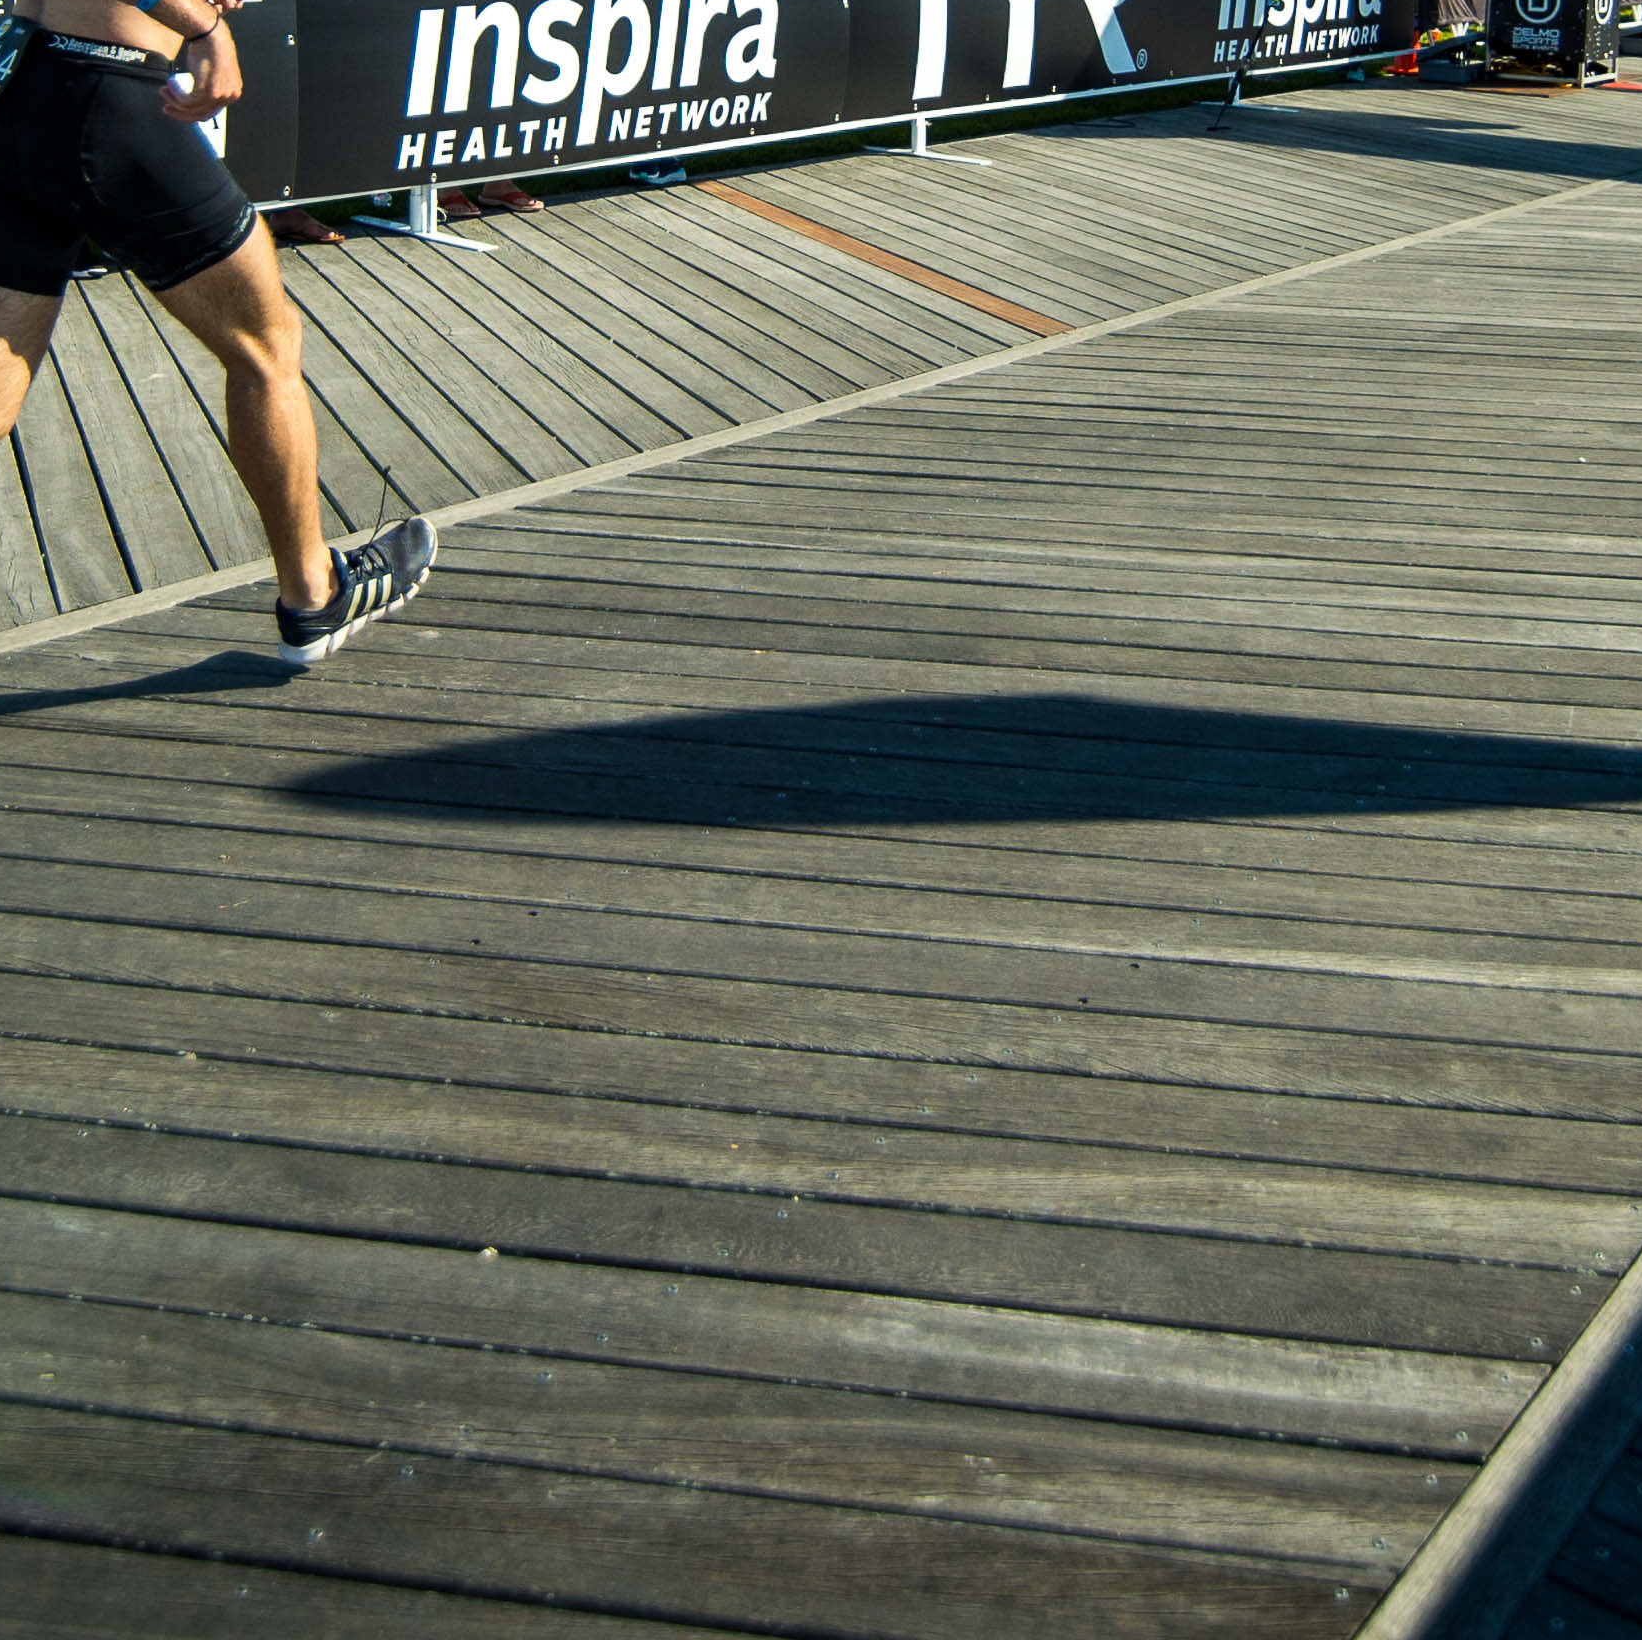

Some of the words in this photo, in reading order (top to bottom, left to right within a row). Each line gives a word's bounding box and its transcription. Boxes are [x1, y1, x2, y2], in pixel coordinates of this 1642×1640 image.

[1214, 34, 1288, 63] HEALTH
[1305, 24, 1380, 53] NETWORK
[397, 115, 567, 171] HEALTH
[608, 91, 773, 142] NETWORK
